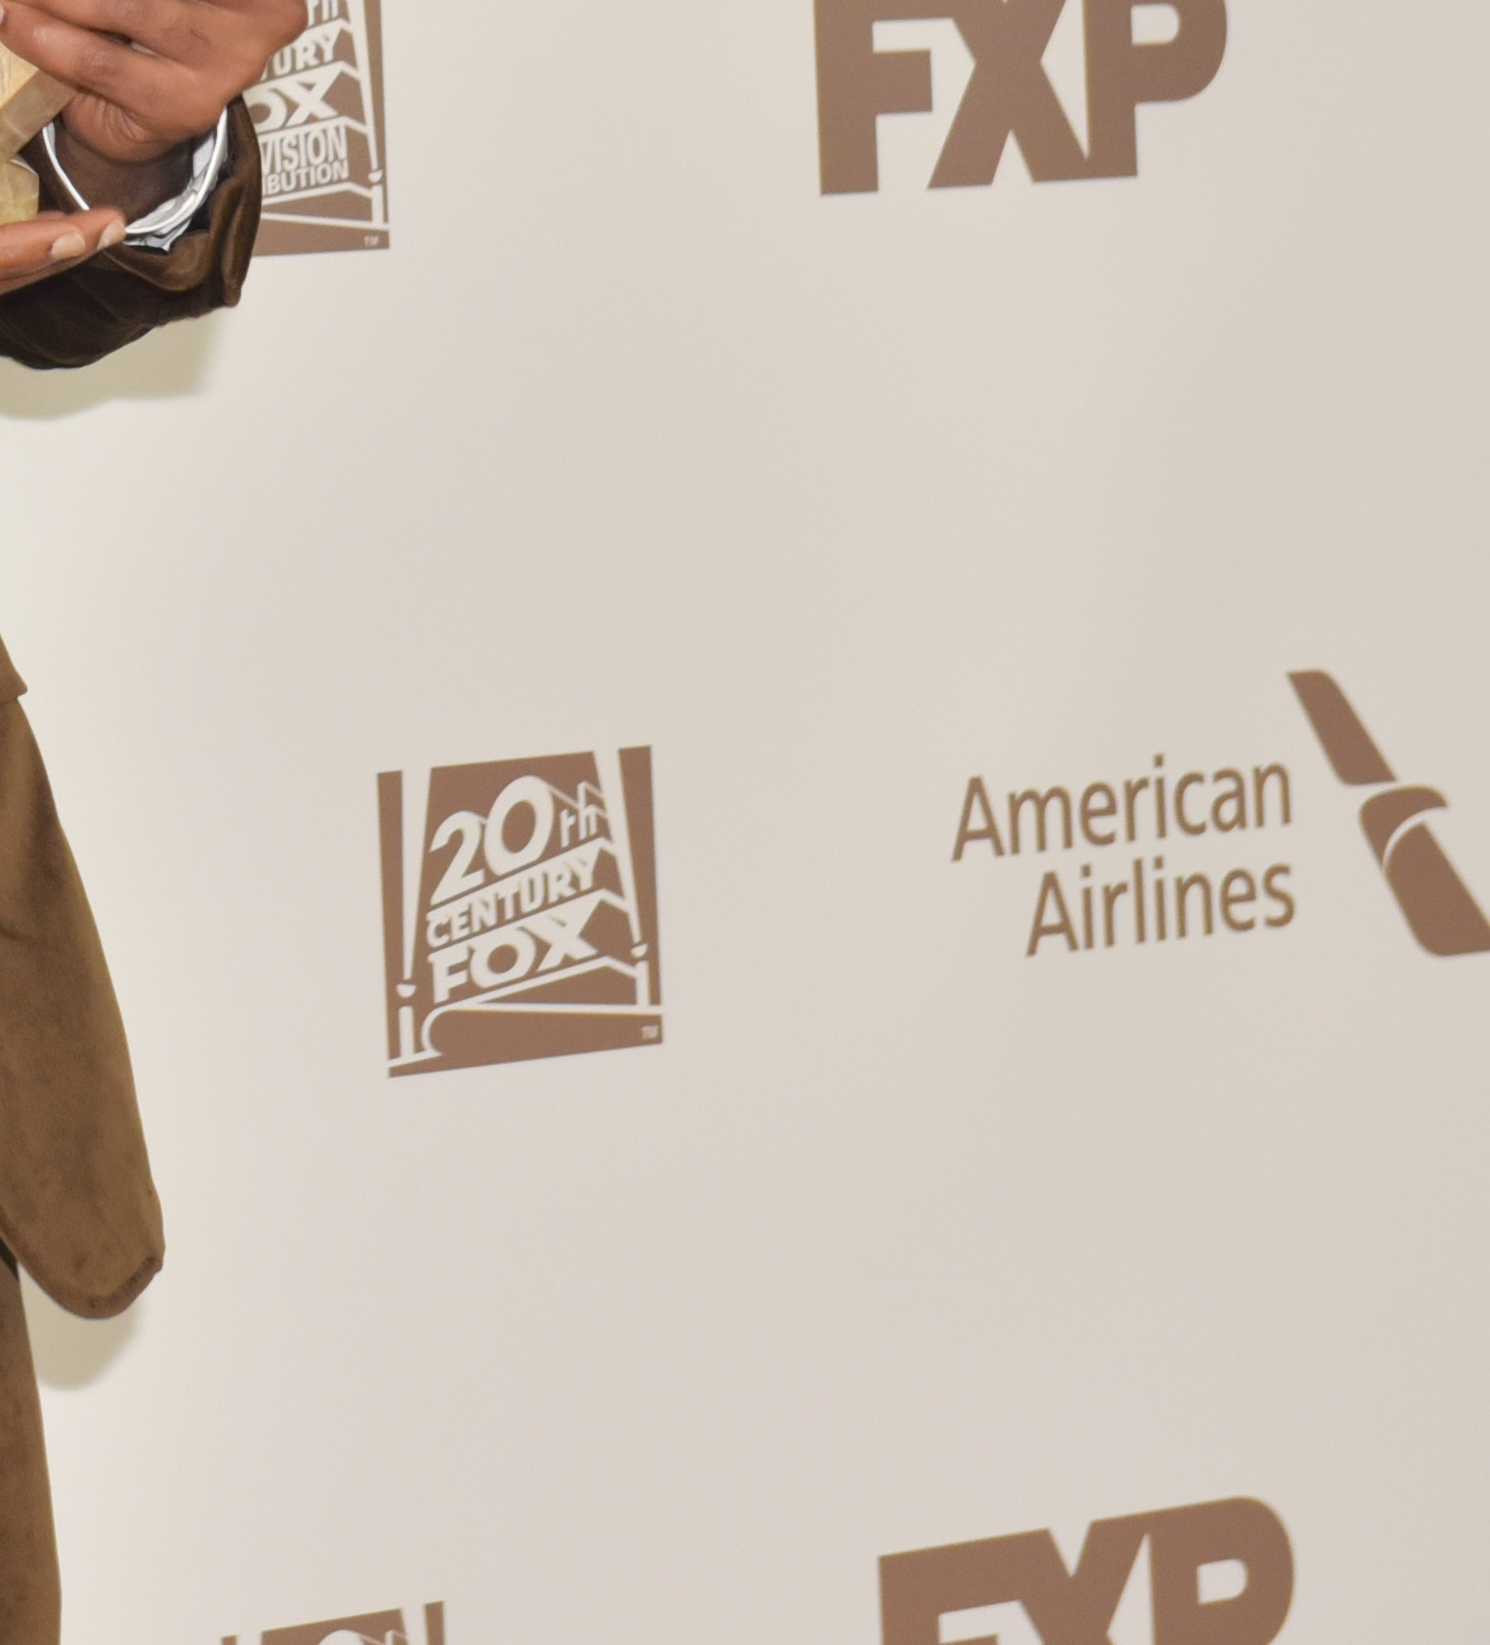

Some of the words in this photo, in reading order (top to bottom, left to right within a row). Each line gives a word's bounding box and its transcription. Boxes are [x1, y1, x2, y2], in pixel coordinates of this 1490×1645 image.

[951, 754, 1292, 862] American
[426, 841, 601, 948] CENTURY
[1025, 855, 1297, 958] Airlines
[428, 895, 601, 1004] FOX
